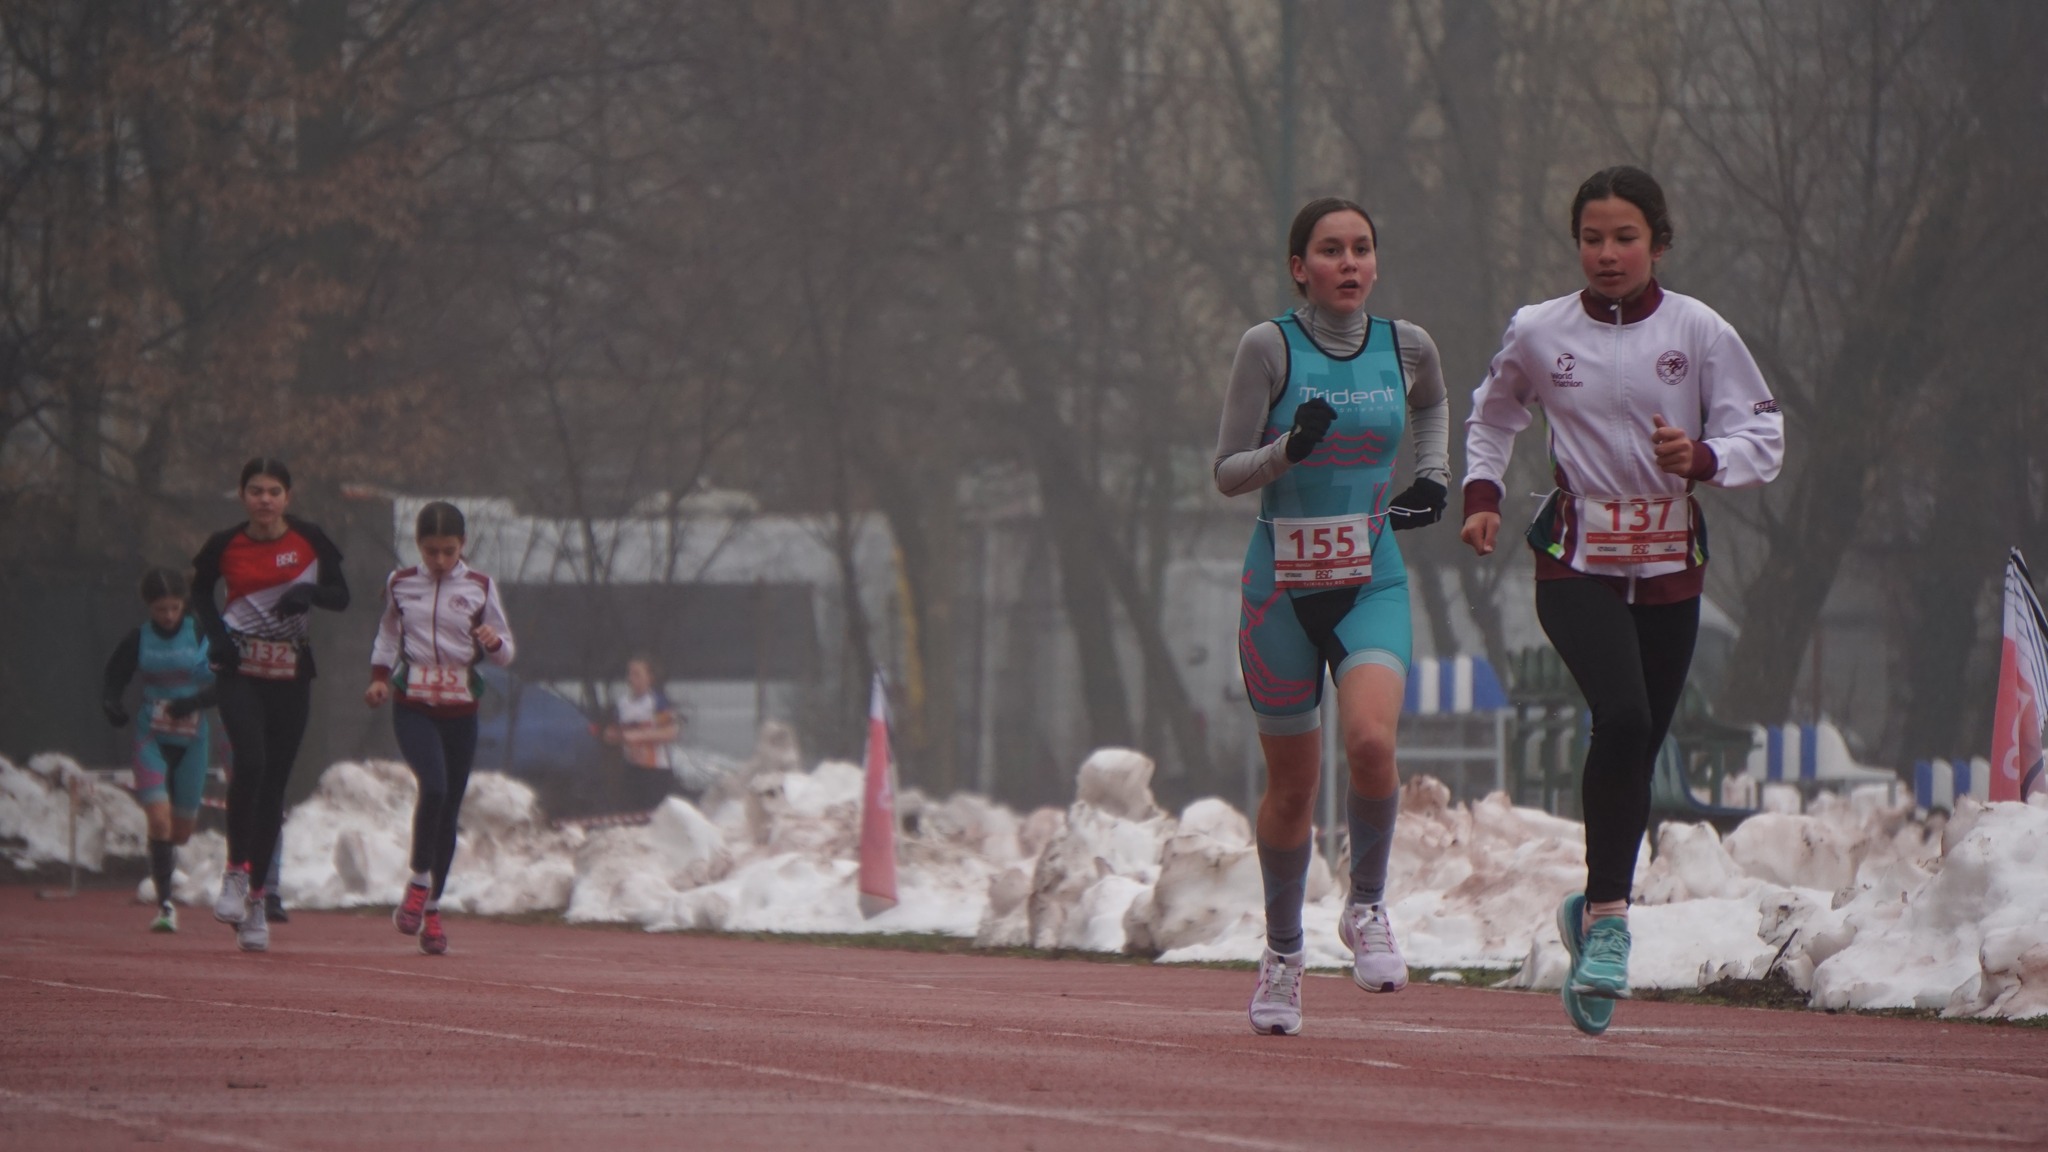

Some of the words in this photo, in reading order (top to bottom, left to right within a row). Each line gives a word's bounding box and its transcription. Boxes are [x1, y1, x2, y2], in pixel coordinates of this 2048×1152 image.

[1551, 371, 1573, 380] World
[1552, 379, 1584, 388] Triathlon
[1299, 386, 1395, 405] Trident
[1605, 498, 1673, 531] 137
[1289, 526, 1355, 559] 155
[276, 551, 298, 567] BSC
[1315, 569, 1333, 580] BSC
[251, 641, 288, 663] 132
[421, 664, 458, 686] 135
